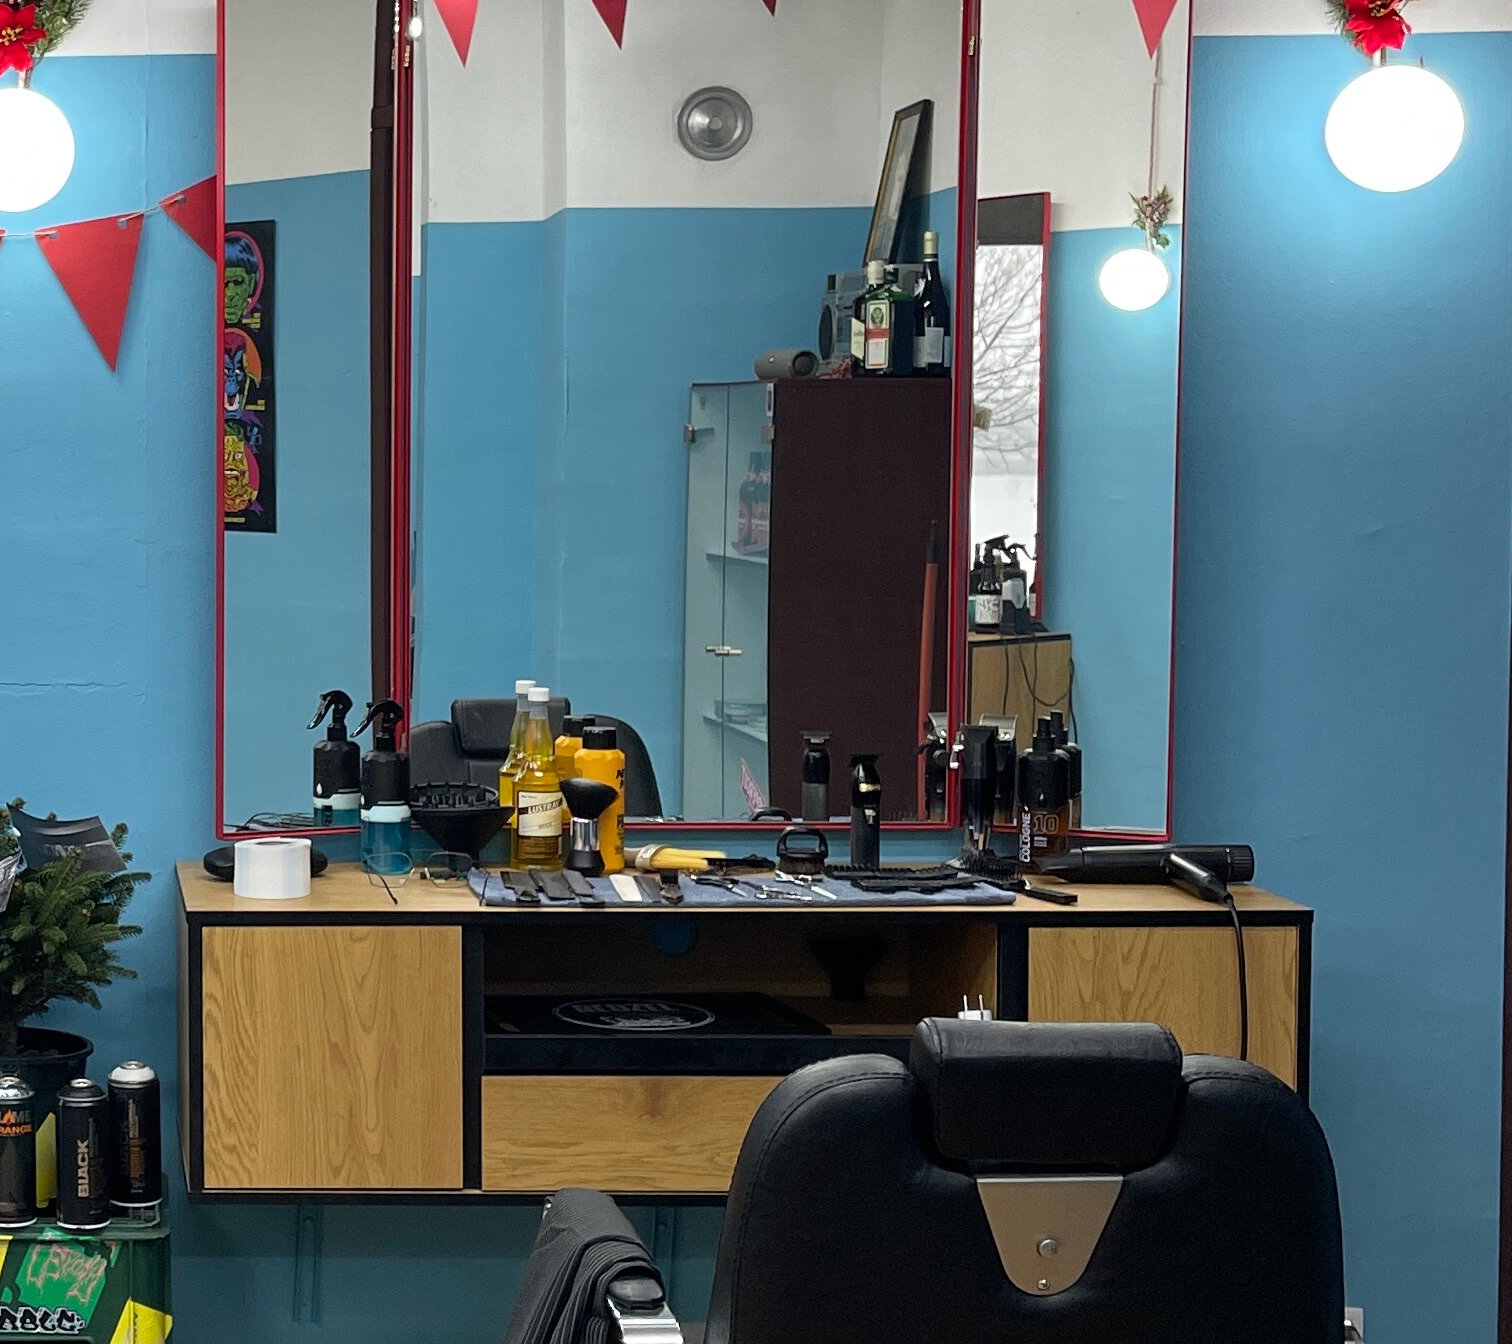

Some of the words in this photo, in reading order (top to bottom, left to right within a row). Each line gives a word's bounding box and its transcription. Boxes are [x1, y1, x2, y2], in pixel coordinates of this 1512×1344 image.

[1021, 811, 1031, 863] COLOGNE
[1033, 814, 1059, 835] 10
[76, 1139, 89, 1198] BLACK
